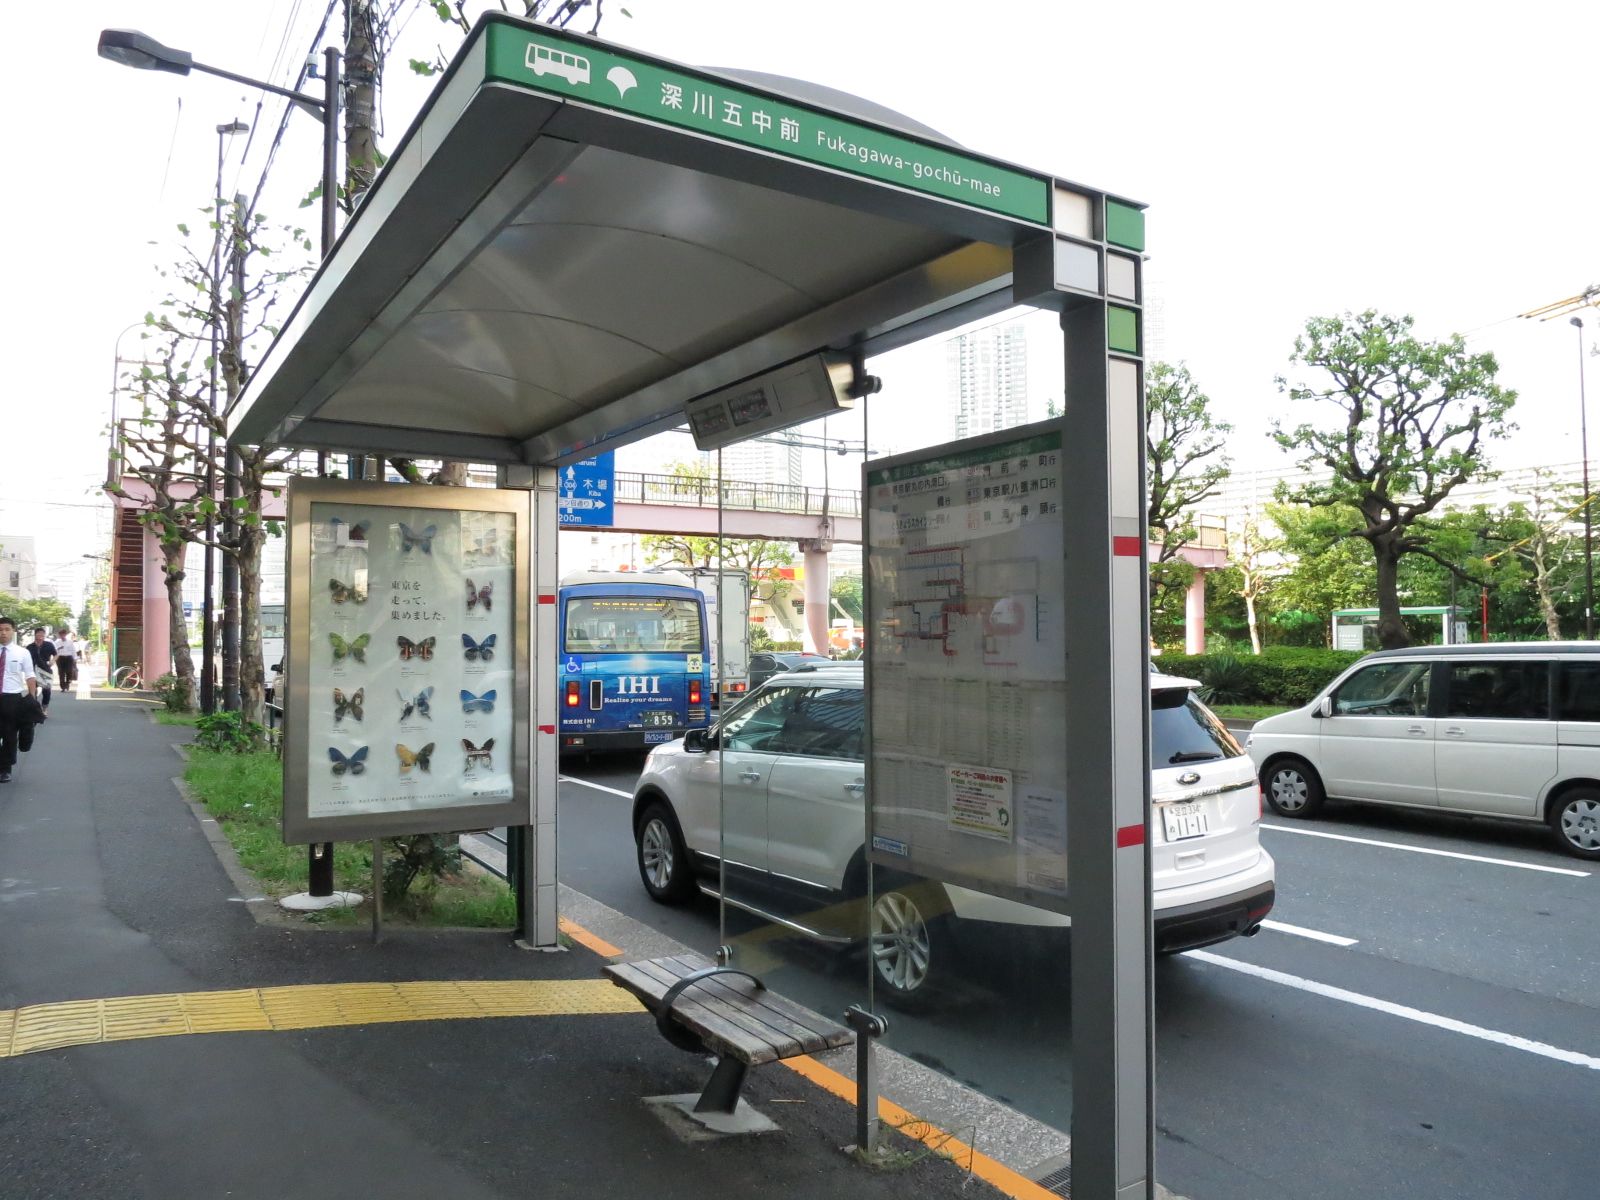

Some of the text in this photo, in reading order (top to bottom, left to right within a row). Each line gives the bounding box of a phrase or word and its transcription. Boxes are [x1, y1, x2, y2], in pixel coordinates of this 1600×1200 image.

[660, 81, 800, 143] 深川五中前
[816, 130, 1001, 197] Fukagawa-gochū-mae
[582, 478, 608, 490] 木場
[391, 580, 421, 591] 東京を
[391, 610, 448, 621] 集めました。
[616, 676, 660, 694] IHI
